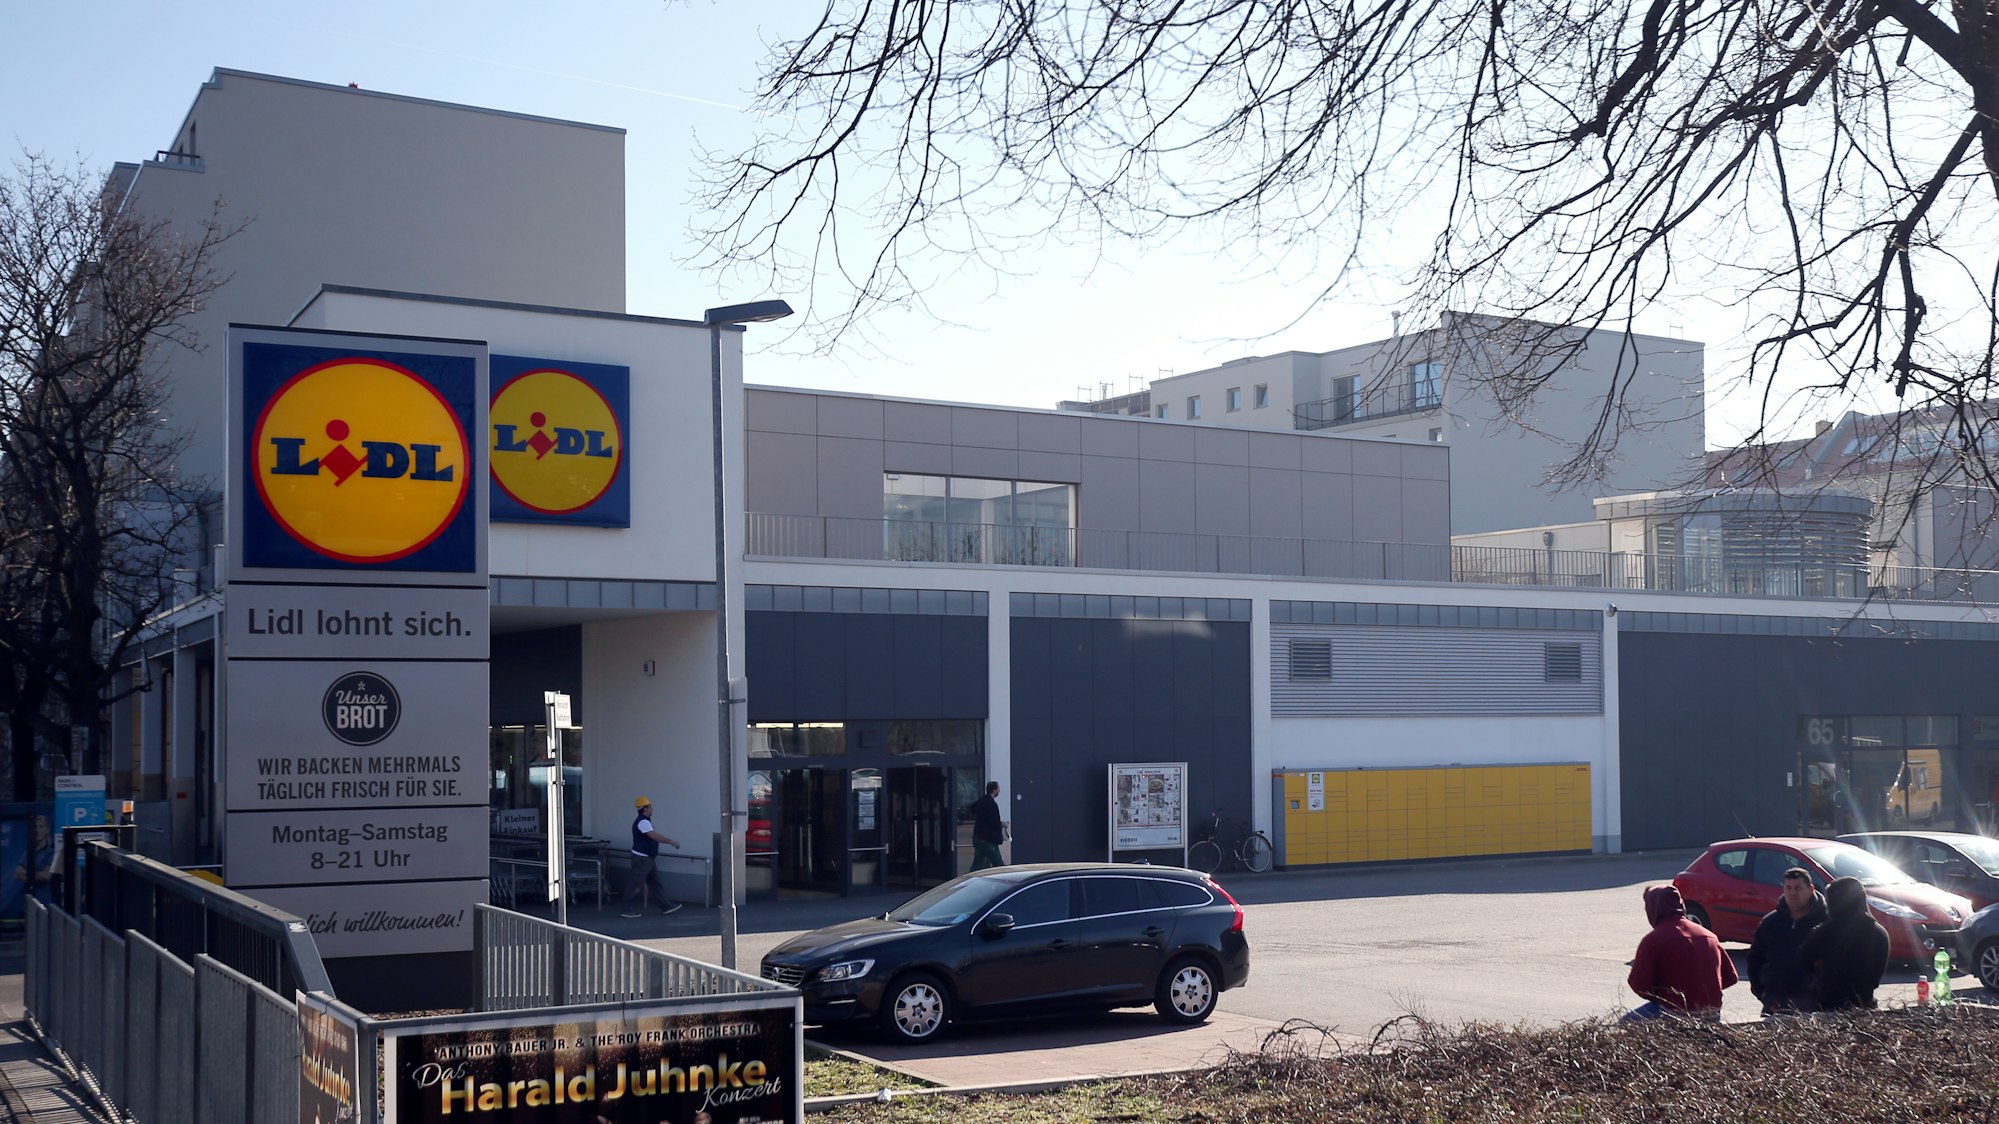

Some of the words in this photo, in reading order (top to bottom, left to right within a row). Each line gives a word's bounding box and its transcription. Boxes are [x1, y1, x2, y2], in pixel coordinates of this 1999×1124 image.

[248, 608, 303, 634] Lidl
[317, 610, 393, 636] lohnt
[404, 611, 471, 637] sich.
[335, 690, 388, 705] Unser
[336, 705, 388, 729] BROT
[1808, 718, 1834, 745] 65
[257, 758, 291, 775] WIR
[297, 757, 363, 775] BACKEN
[368, 756, 460, 774] MEHRMALS
[257, 779, 325, 800] TÄGLICH
[331, 781, 389, 799] FRISCH
[396, 777, 427, 797] FÜR
[432, 779, 461, 797] SIE.
[504, 814, 536, 823] Kleiner
[373, 849, 411, 867] Uhr
[306, 911, 336, 934] lich
[343, 909, 465, 933] willkommen!
[439, 1044, 500, 1059] ANTHONY
[506, 1040, 546, 1054] BAUER
[552, 1038, 569, 1050] JR.
[575, 1038, 585, 1047] &
[591, 1034, 613, 1046] THE
[619, 1032, 641, 1044] ROY
[646, 1031, 685, 1042] FRANK
[691, 1023, 760, 1039] ORCHESTRA
[412, 1062, 468, 1089] Das
[441, 1064, 595, 1115] Harald
[607, 1053, 767, 1099] Juhnke
[695, 1076, 781, 1113] Konzert
